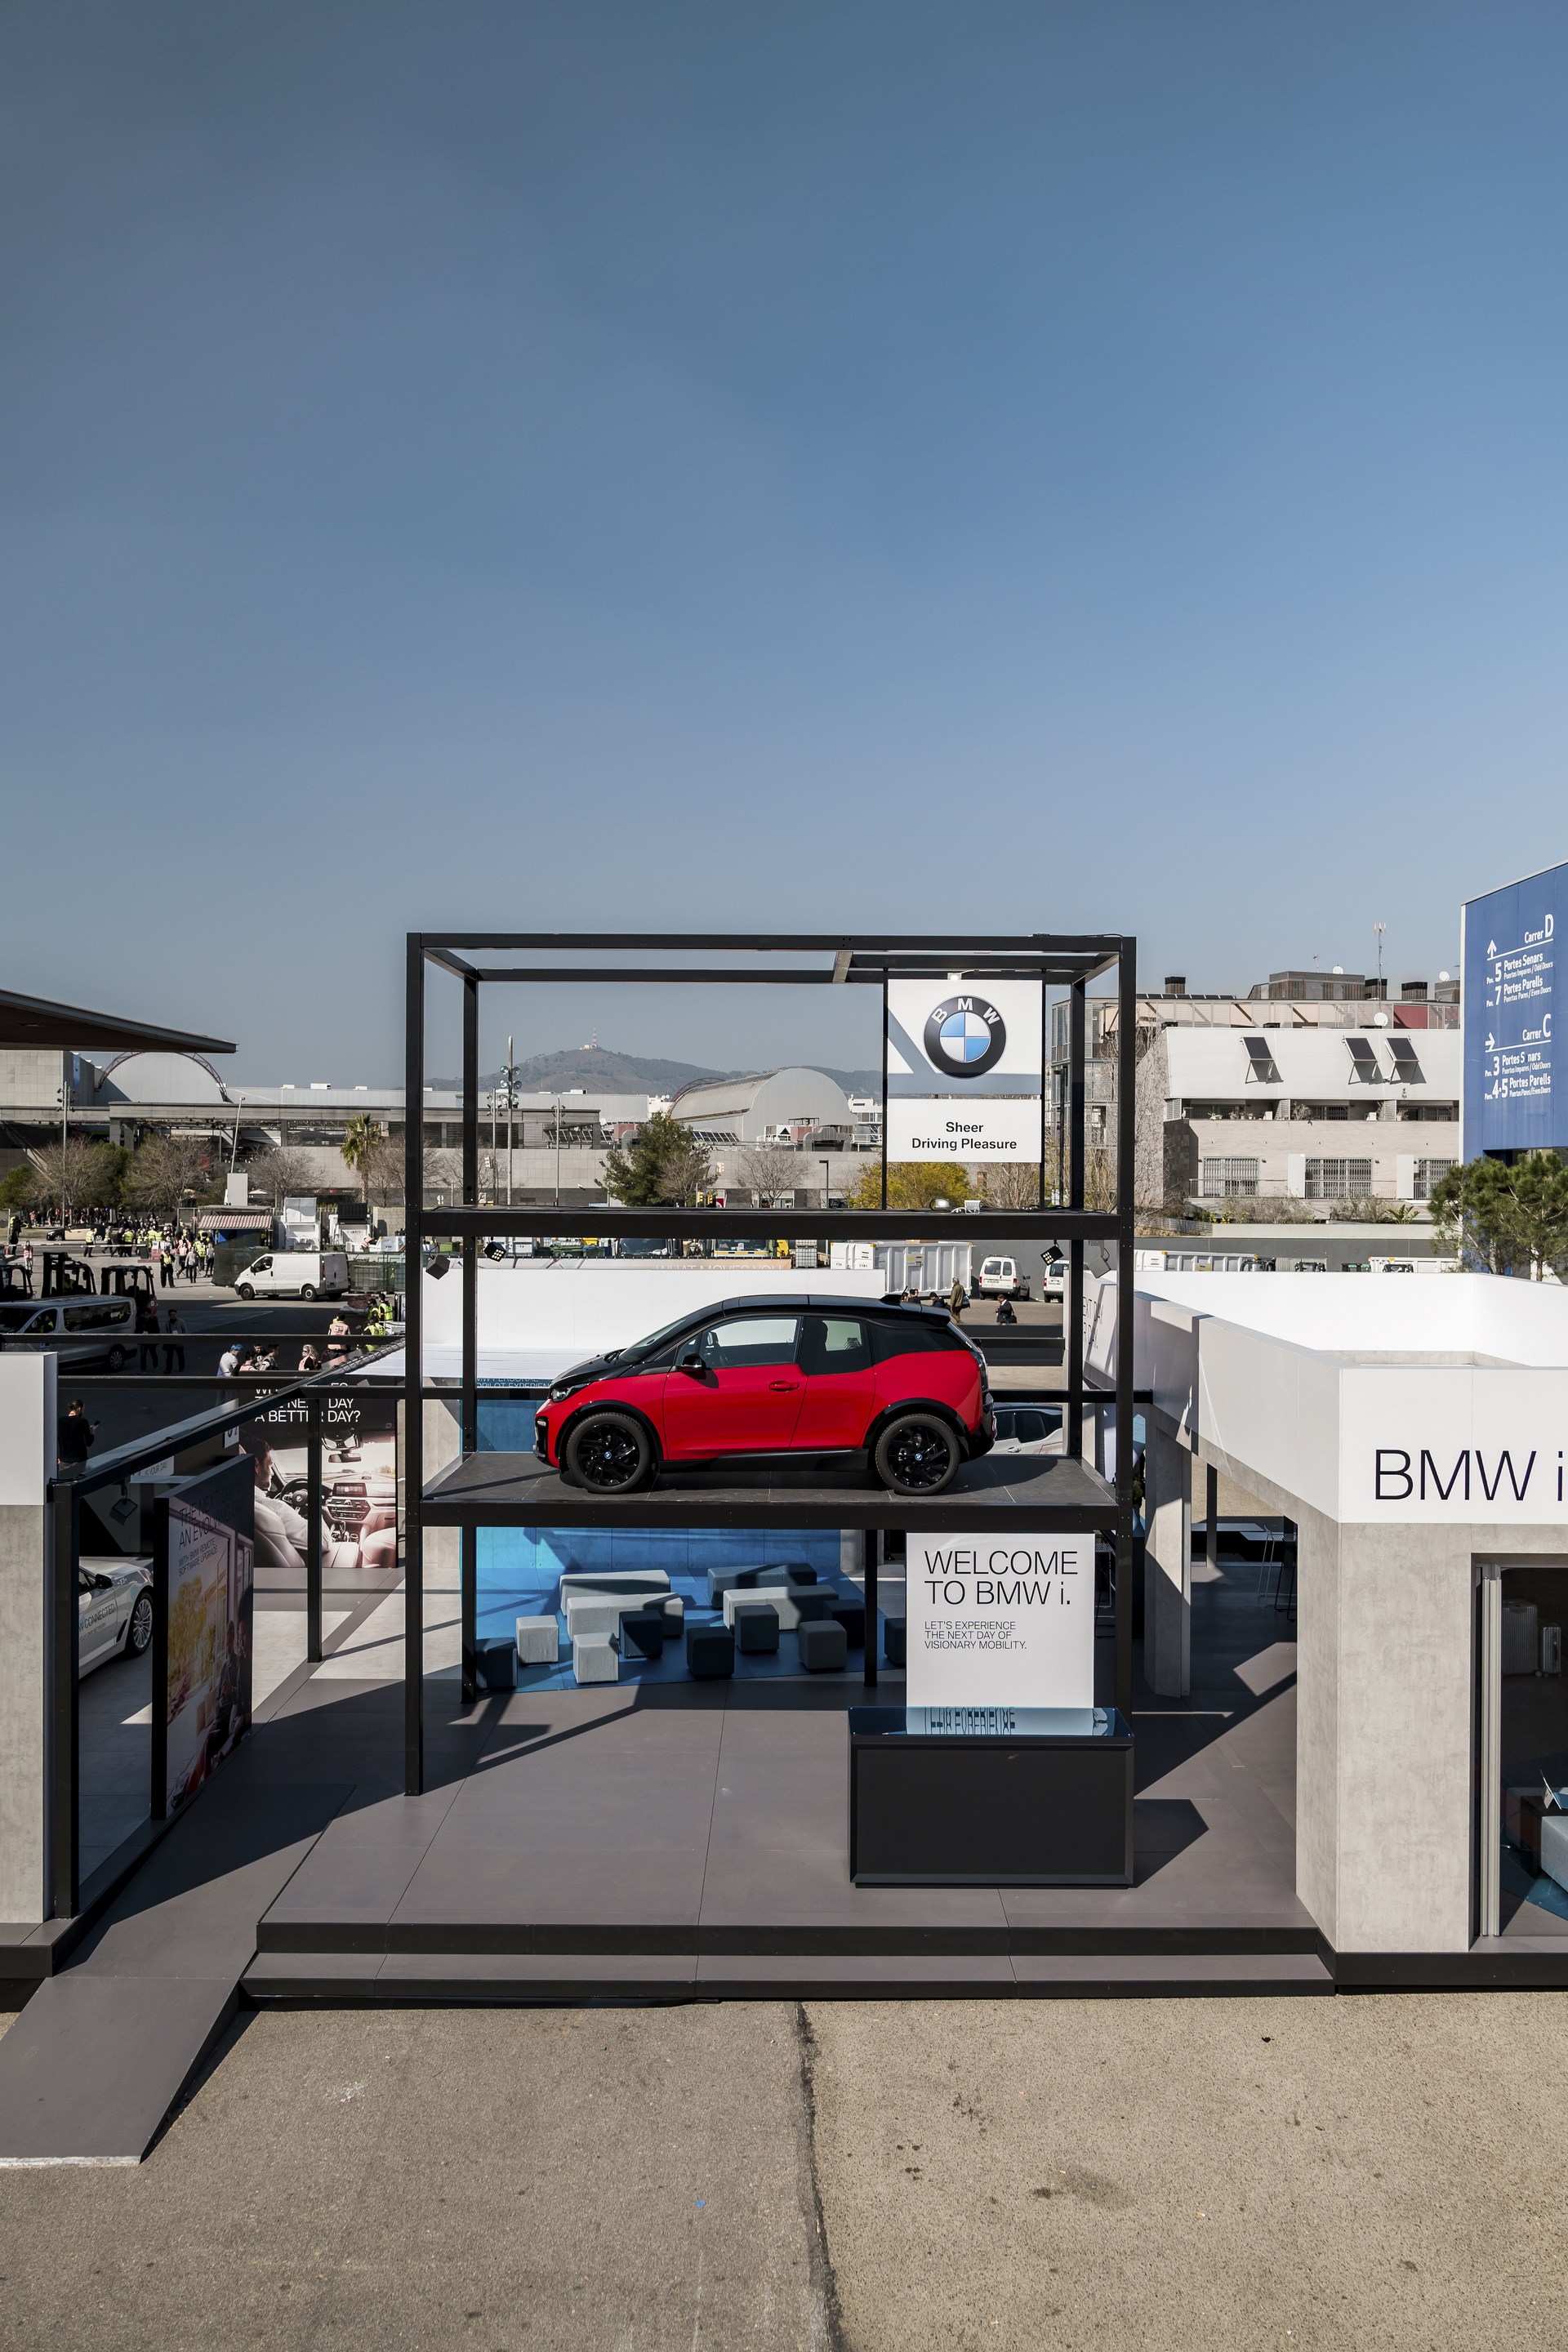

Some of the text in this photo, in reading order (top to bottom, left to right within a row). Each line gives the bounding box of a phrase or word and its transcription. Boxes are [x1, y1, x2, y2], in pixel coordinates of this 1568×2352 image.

[1524, 914, 1554, 943] Carrer D
[1495, 962, 1502, 982] 5
[1504, 958, 1522, 971] Portes
[1523, 953, 1543, 966] Senars
[1504, 971, 1517, 980] Puertas
[1517, 967, 1531, 977] Impares
[1495, 986, 1501, 1005] 7
[1504, 982, 1521, 995] Portes
[1522, 975, 1543, 990] Parells
[1518, 991, 1528, 1000] Pares
[931, 998, 1000, 1024] BMW
[1523, 1013, 1551, 1041] Carrer C
[1493, 1056, 1500, 1076] 3
[1502, 1055, 1519, 1066] Portes
[1521, 1051, 1541, 1063] Snars
[1502, 1067, 1515, 1075] Puertas
[1515, 1065, 1529, 1074] Impares
[1510, 1077, 1528, 1089] Portes
[1529, 1073, 1551, 1086] Parells
[946, 1121, 984, 1133] Sheer
[912, 1138, 1017, 1152] Driving Pleasure
[329, 1399, 354, 1408] DAY
[328, 1410, 361, 1422] DAY?
[1375, 1449, 1563, 1501] BMW i
[179, 1502, 196, 1527] THE
[179, 1526, 191, 1551] AN
[178, 1556, 200, 1577] SOFTWARE
[179, 1554, 189, 1566] WITH
[190, 1547, 199, 1561] BMW
[924, 1550, 1078, 1575] WELCOME
[924, 1580, 1070, 1605] TO BMW i.
[925, 1621, 1016, 1630] LET'S EXPERIENCE
[925, 1631, 1012, 1639] THE NEXT DAY OF
[924, 1641, 1027, 1649] VISIONARY MOBILITY.
